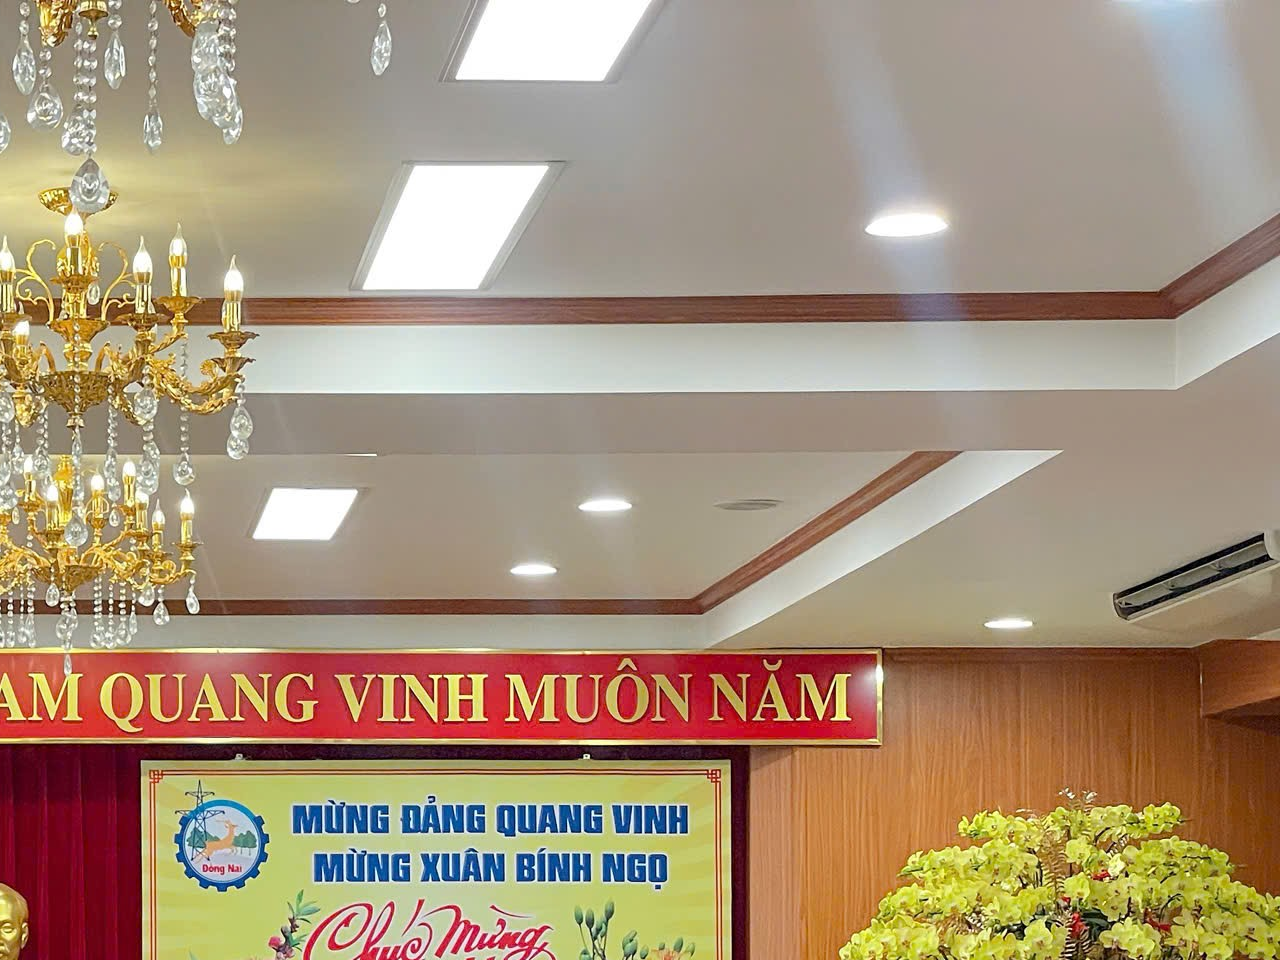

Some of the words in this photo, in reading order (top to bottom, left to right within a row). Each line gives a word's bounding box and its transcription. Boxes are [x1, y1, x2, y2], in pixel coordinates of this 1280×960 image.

[100, 673, 318, 732] QUANG
[335, 673, 489, 723] VINH
[505, 658, 691, 723] MUÔN
[708, 659, 852, 722] NĂM
[292, 800, 389, 834] MỪNG
[401, 796, 486, 834] ĐẢNG
[497, 804, 603, 837] QUANG
[612, 804, 689, 834] VINH
[228, 864, 242, 873] Nai
[313, 848, 410, 882] MỪNG
[421, 848, 505, 882] XUÂN
[515, 848, 591, 882] BÍNH
[602, 852, 669, 890] NGỌ
